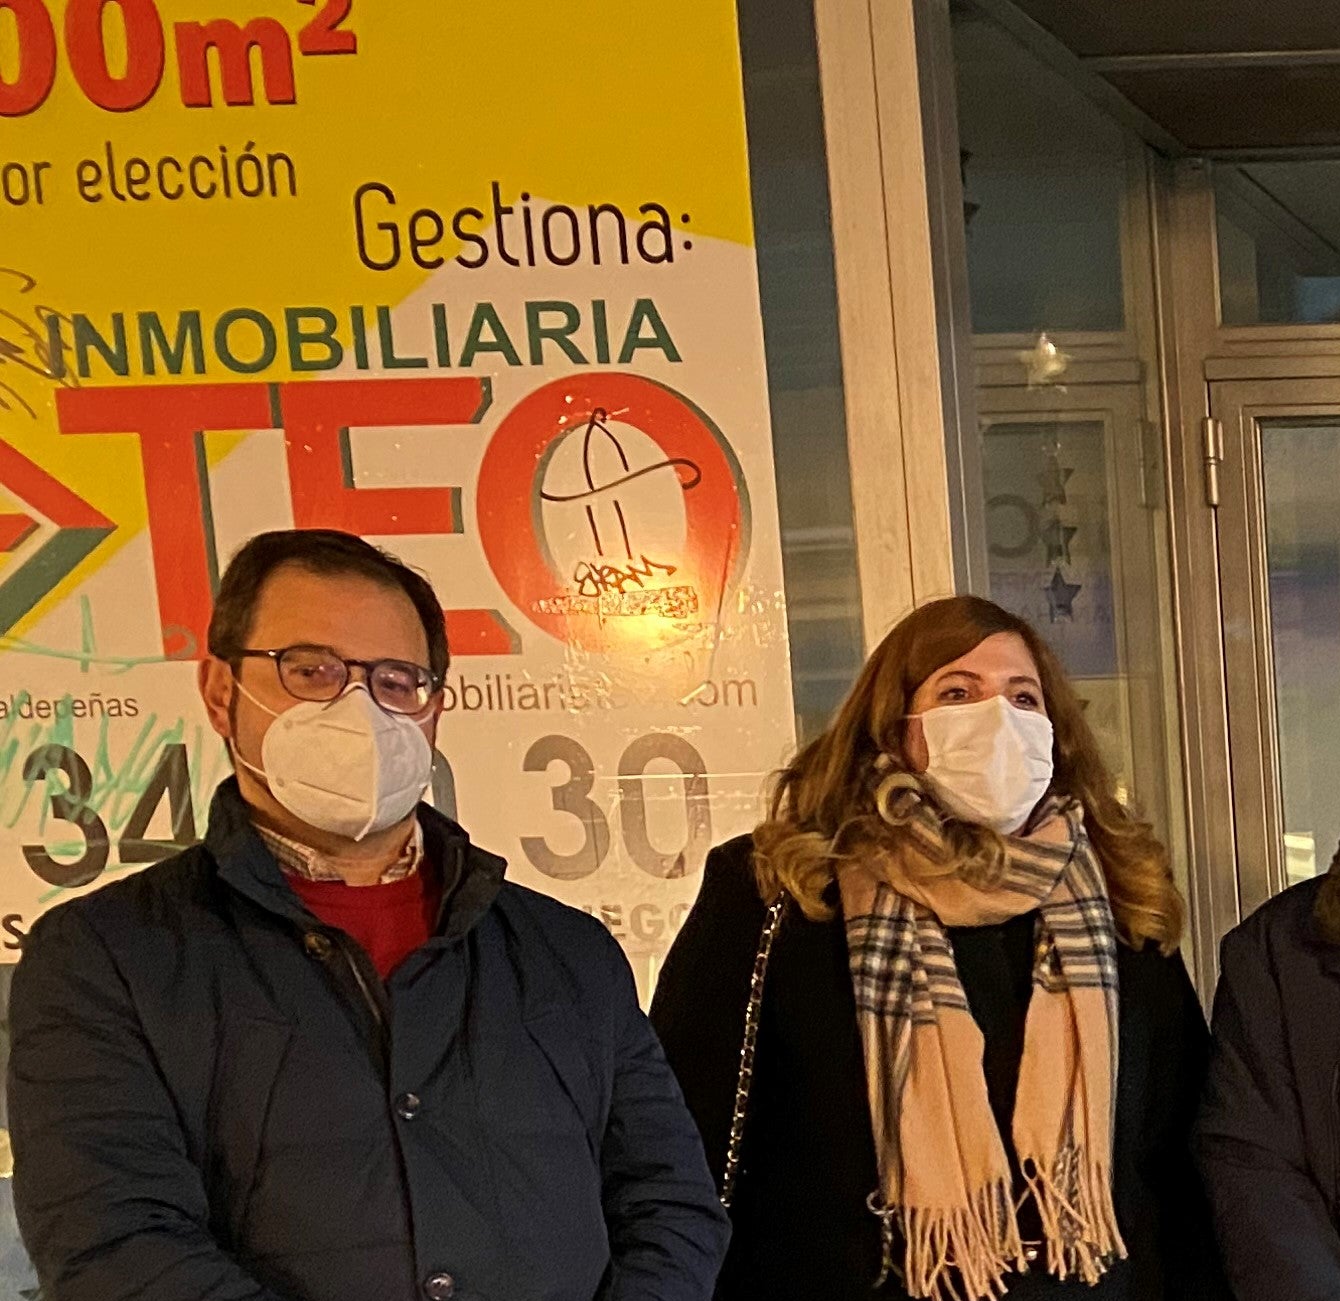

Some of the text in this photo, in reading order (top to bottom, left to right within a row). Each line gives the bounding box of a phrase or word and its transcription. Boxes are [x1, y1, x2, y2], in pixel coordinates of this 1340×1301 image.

[77, 142, 297, 203] elección
[353, 182, 693, 271] Gestiona:
[47, 298, 682, 377] INMOBILIARIA
[519, 733, 713, 882] 30
